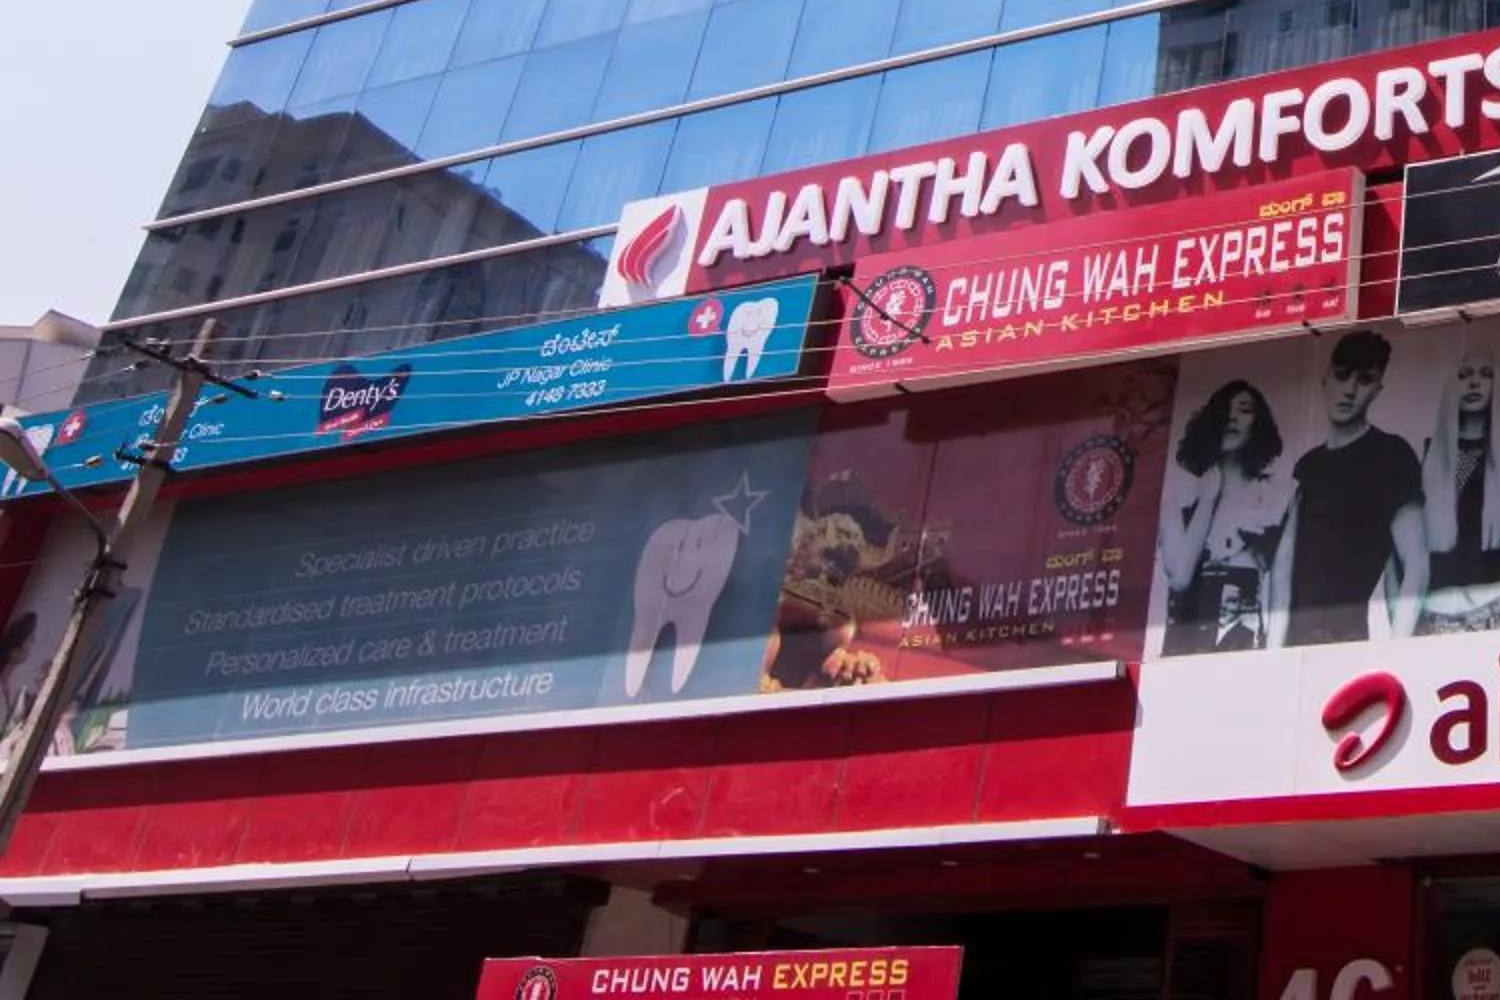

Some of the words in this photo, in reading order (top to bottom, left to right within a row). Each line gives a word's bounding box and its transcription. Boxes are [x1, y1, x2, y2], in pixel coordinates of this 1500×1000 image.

[698, 143, 1040, 267] AJANTHA
[942, 260, 1068, 327] CHUNG
[1082, 242, 1159, 302] WAH
[1172, 213, 1345, 290] EXPRESS
[935, 320, 1046, 352] ASIAN
[1060, 290, 1226, 332] KITCHEN
[323, 378, 399, 413] Denty's
[497, 367, 519, 389] JP
[520, 363, 567, 385] Nagar
[569, 356, 613, 377] Clinic
[295, 542, 406, 580] Specialist
[412, 533, 486, 564] driven
[490, 518, 595, 559] practice
[184, 595, 337, 635] Standardised
[340, 580, 457, 618] treatment
[458, 566, 584, 611] protocols
[901, 586, 973, 629] CHUNG
[978, 579, 1022, 620] WAH
[1028, 569, 1121, 615] EXPRESS
[204, 638, 355, 678] Personalized
[358, 635, 412, 662] care
[416, 628, 437, 658] &
[443, 614, 569, 651] treatment
[898, 632, 957, 648] ASIAN
[965, 620, 1056, 642] KITCHEN
[242, 689, 314, 719] World
[315, 686, 379, 715] class
[384, 670, 554, 709] infrastructure
[591, 967, 691, 994] CHUNG
[701, 965, 762, 991] WAH
[772, 959, 909, 990] EXPRESS
